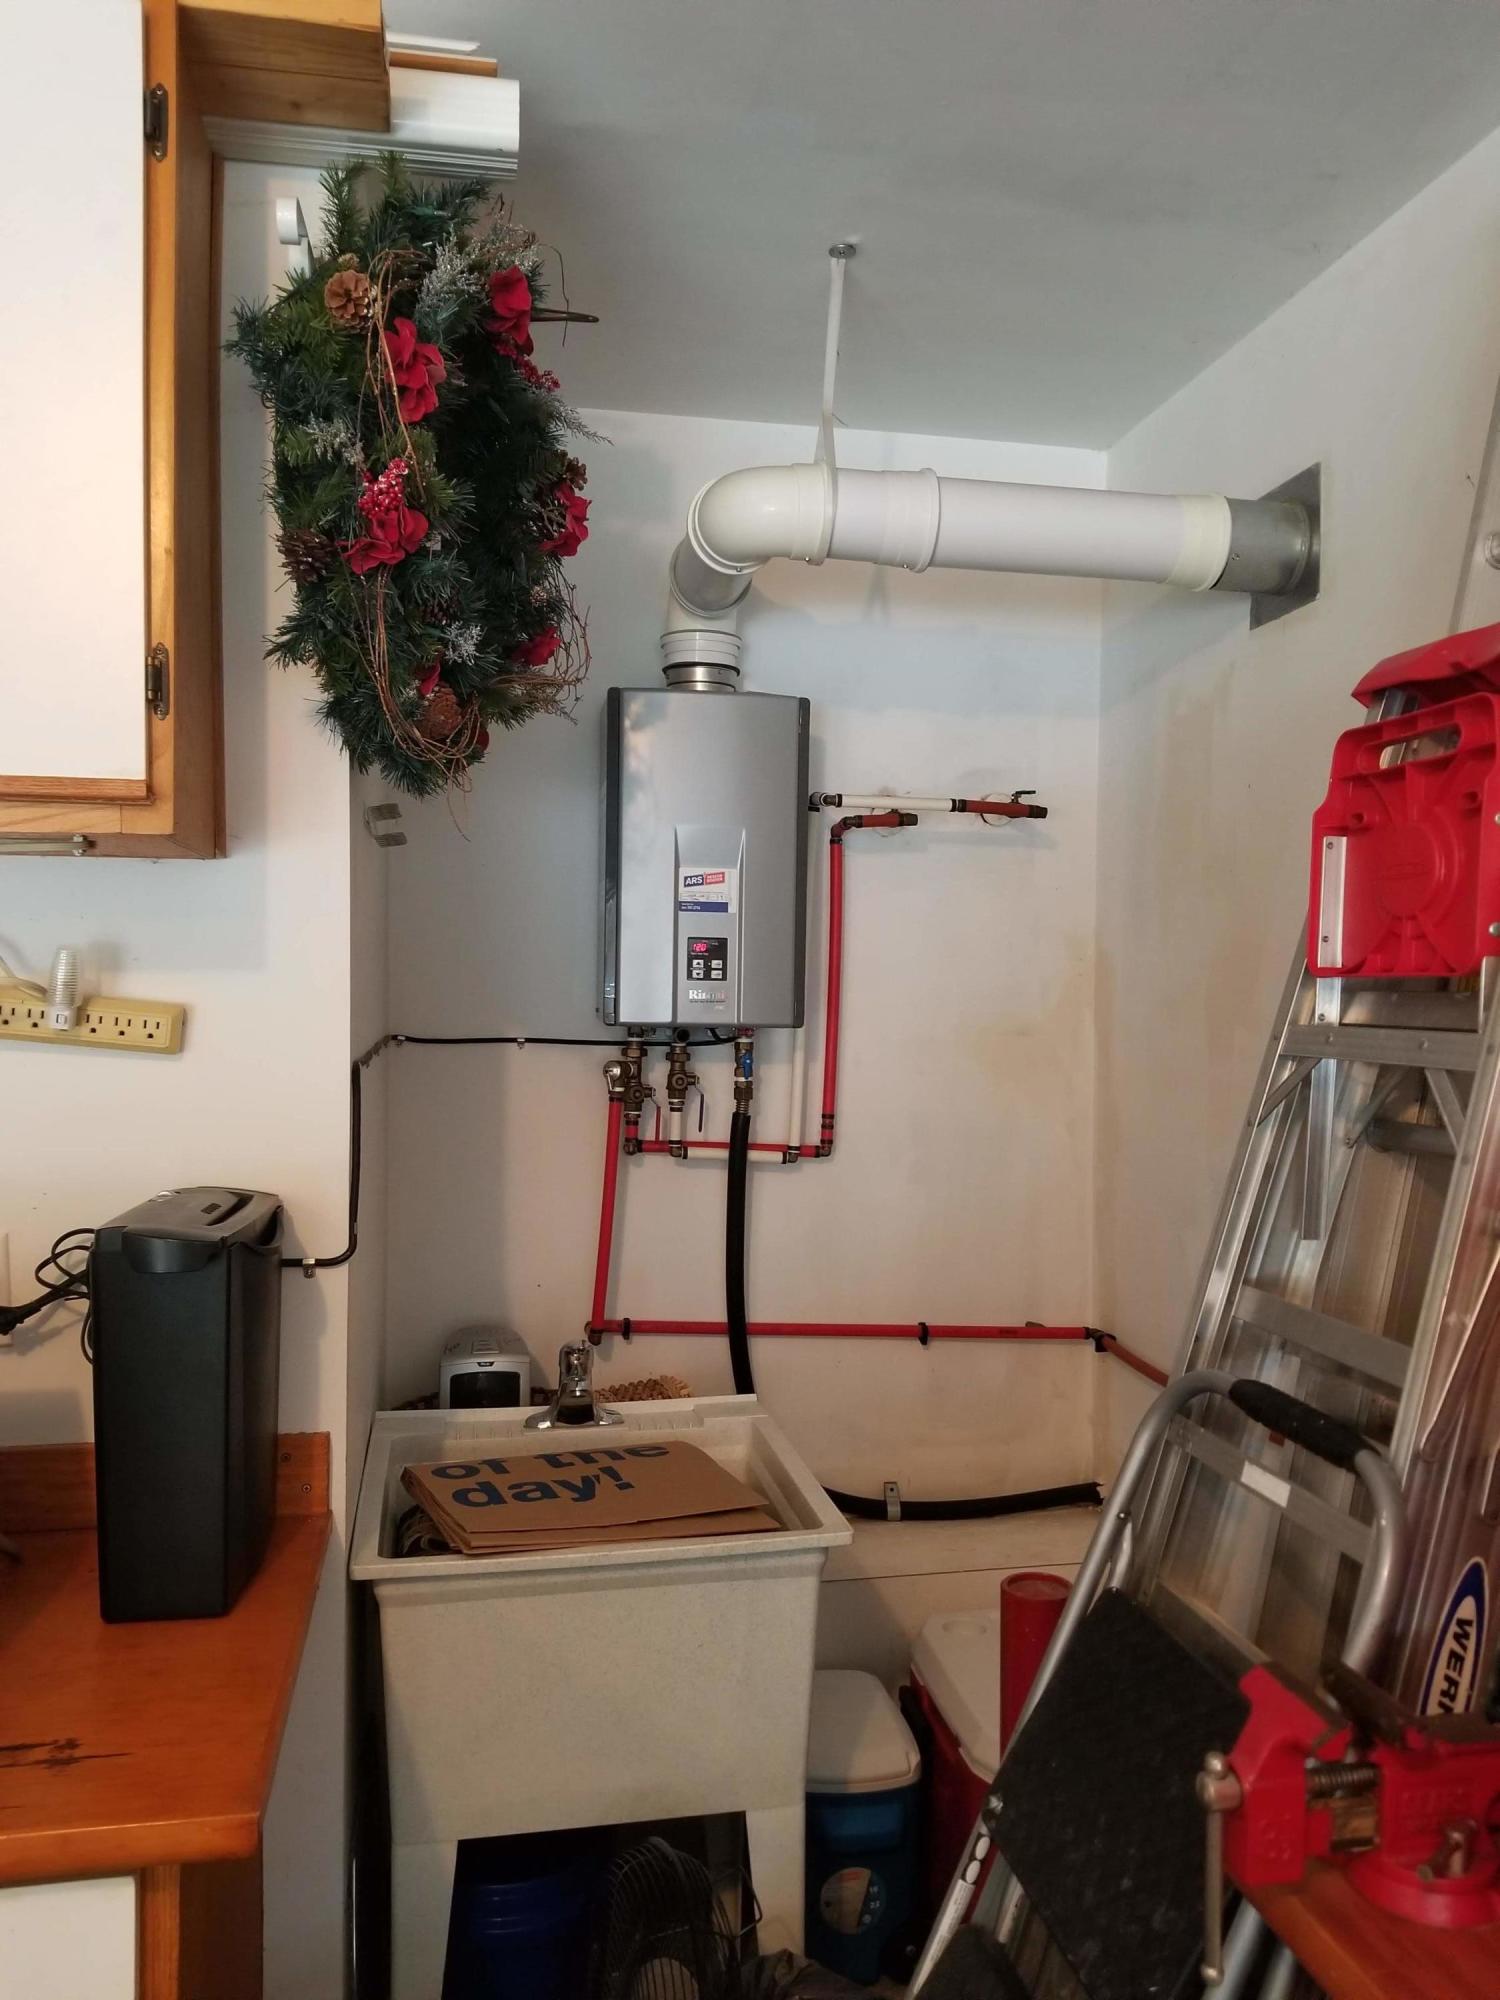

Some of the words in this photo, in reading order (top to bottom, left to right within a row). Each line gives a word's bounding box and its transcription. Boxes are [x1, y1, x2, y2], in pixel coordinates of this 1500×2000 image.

[685, 876, 703, 886] ARS
[693, 943, 707, 952] 120
[431, 1457, 511, 1480] of
[534, 1445, 670, 1469] the
[452, 1465, 635, 1508] day!
